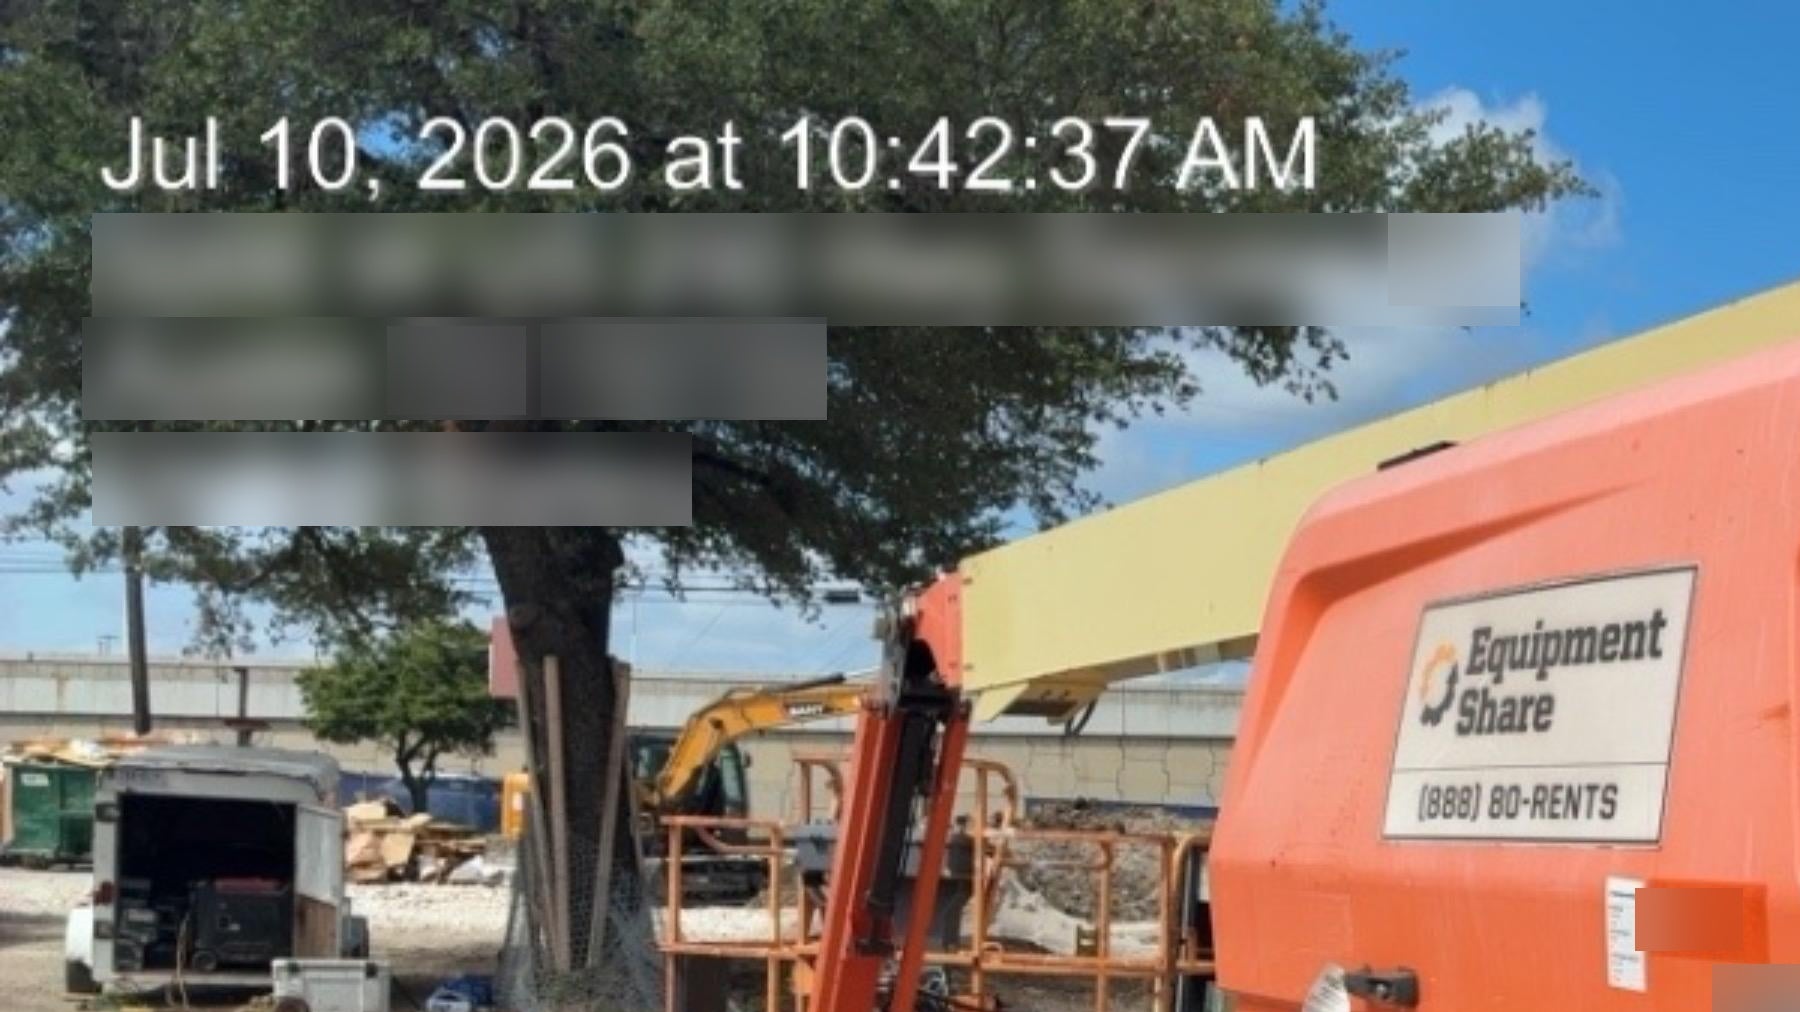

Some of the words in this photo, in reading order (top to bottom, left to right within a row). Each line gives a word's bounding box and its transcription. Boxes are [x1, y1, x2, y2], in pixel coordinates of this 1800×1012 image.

[1465, 608, 1668, 685] Equipment
[1455, 686, 1556, 737] Share
[1418, 781, 1482, 823] (888)
[1488, 783, 1619, 821] 80-RENTS
